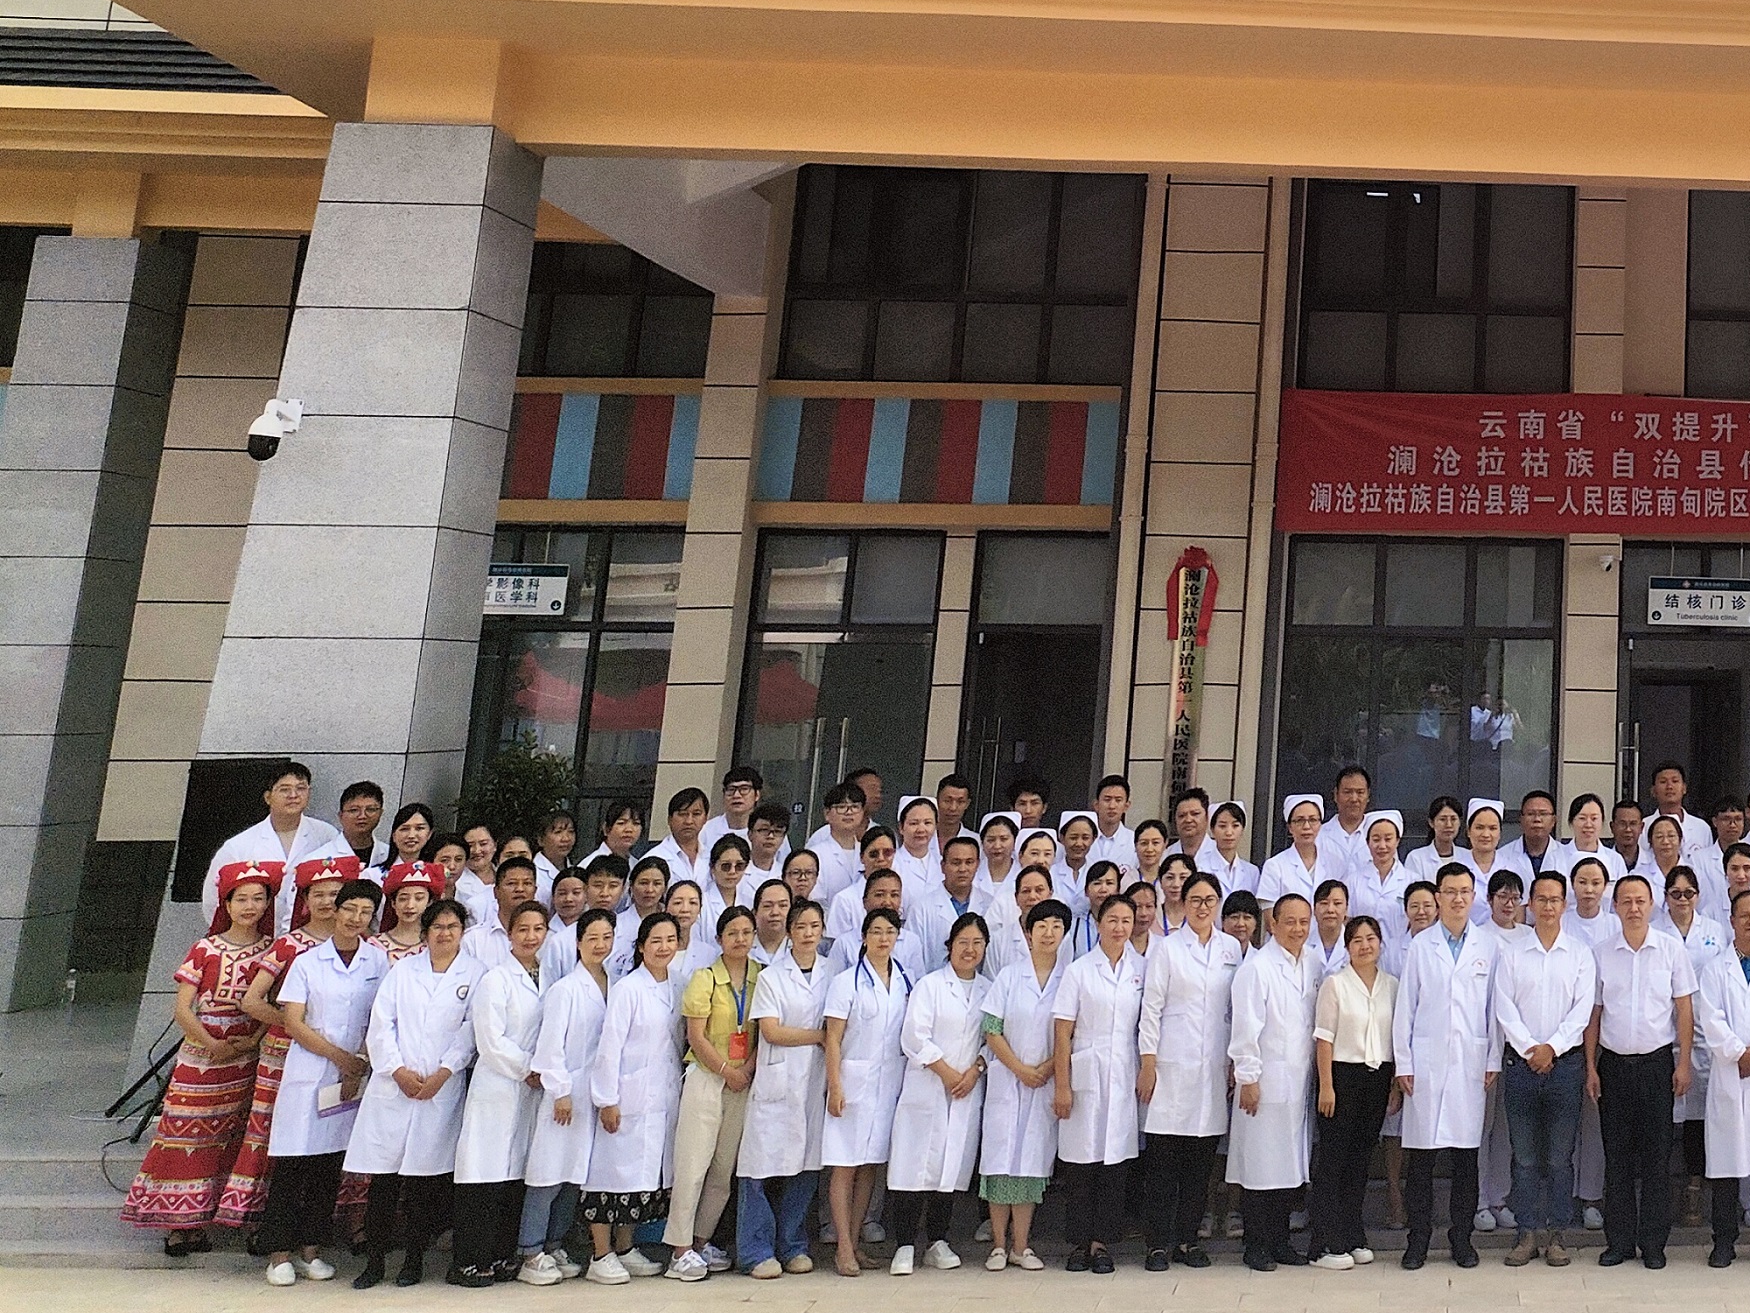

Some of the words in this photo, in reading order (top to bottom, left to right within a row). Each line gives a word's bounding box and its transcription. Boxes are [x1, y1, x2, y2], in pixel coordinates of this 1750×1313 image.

[1664, 593, 1747, 611] 结核门诊
[1676, 612, 1719, 621] Tuberculosis
[1169, 568, 1202, 823] 澜沧拉祜族自治县第一人民医院南甸
